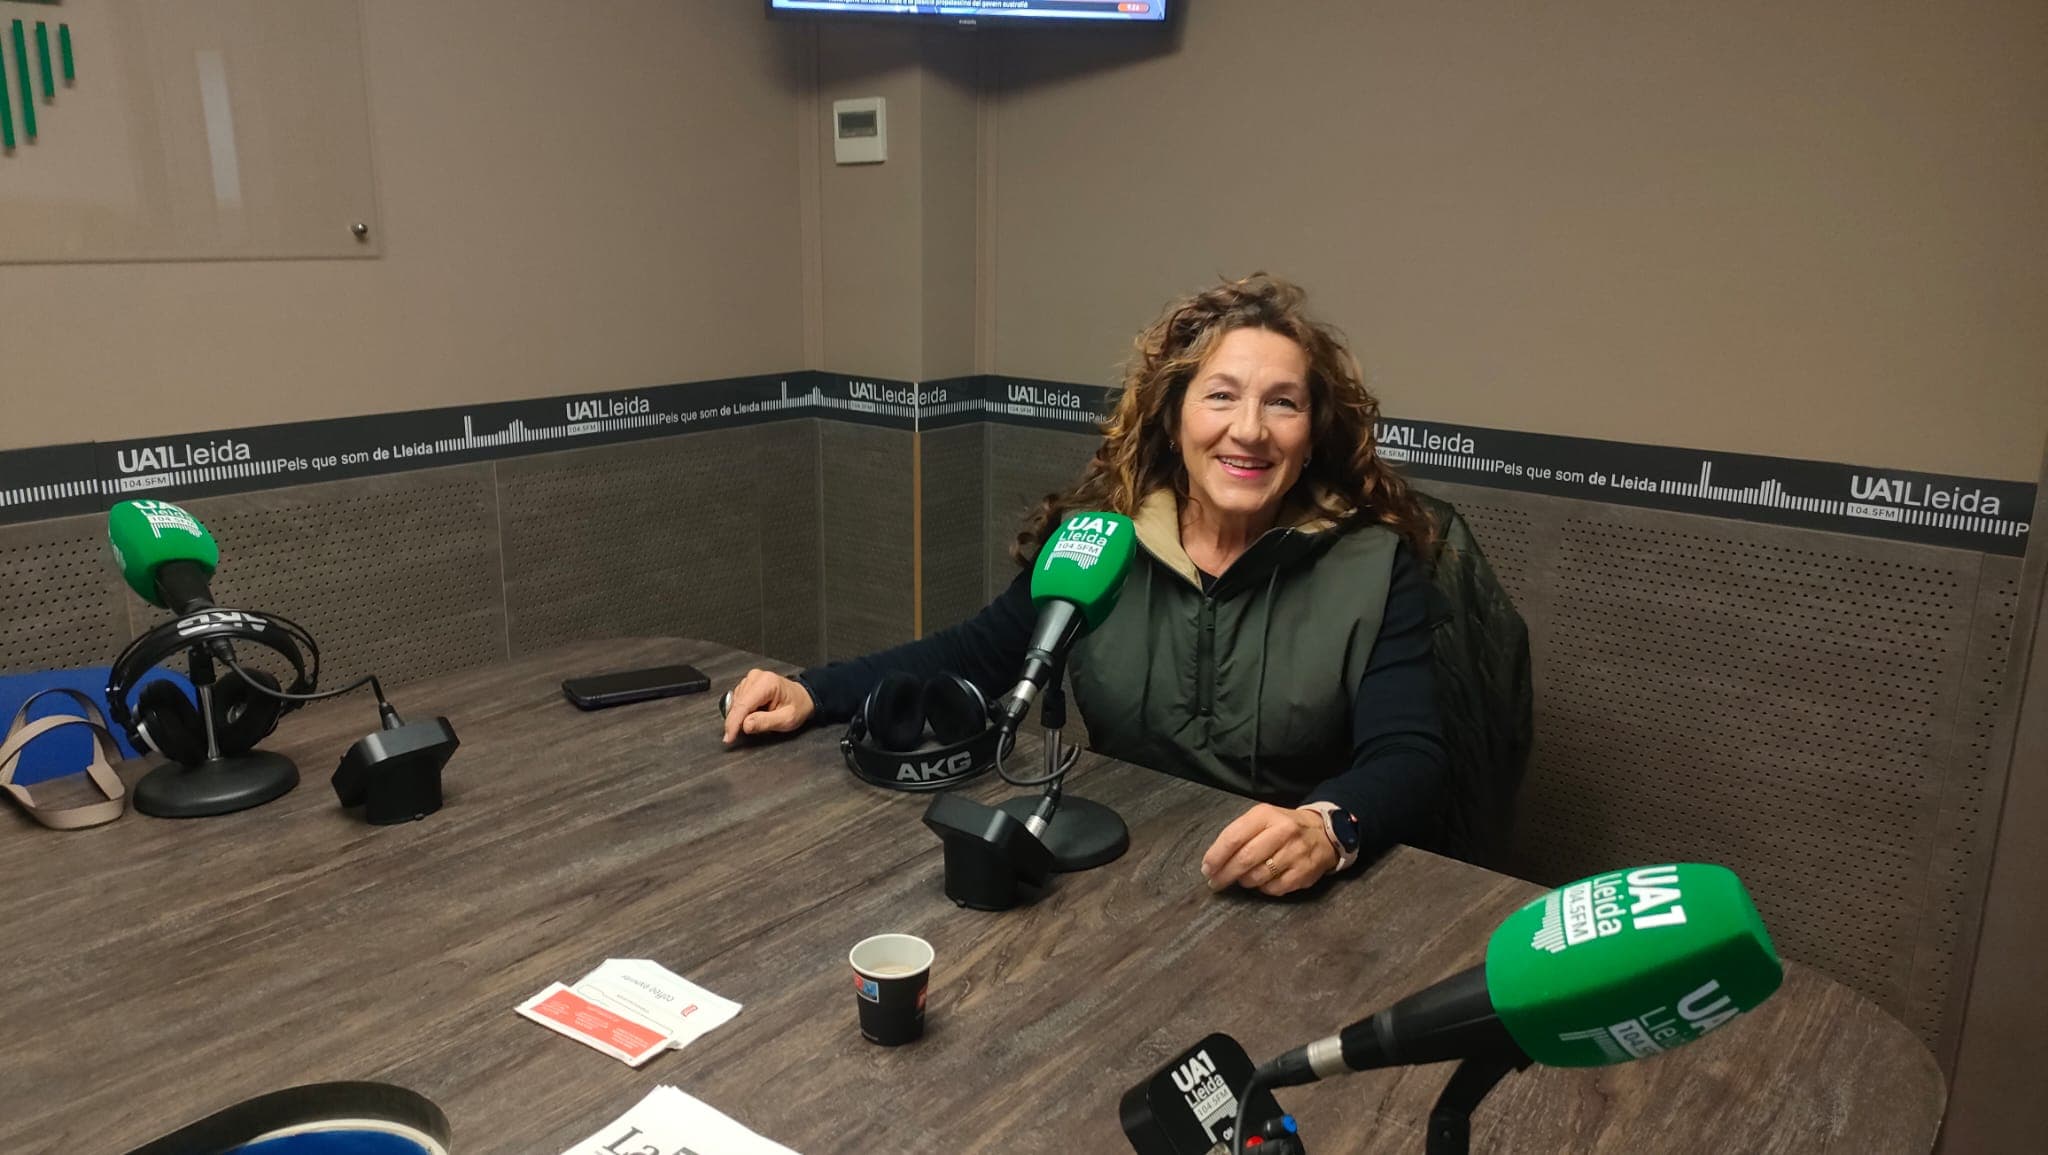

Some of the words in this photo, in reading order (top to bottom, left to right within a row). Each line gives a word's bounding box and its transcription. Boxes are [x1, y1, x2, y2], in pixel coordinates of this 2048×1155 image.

[566, 396, 650, 422] UA1Lleida
[1008, 384, 1080, 408] UA1Lleida
[659, 411, 679, 425] Pels
[680, 410, 698, 425] que
[700, 407, 718, 420] som
[720, 404, 732, 417] de
[733, 401, 760, 416] Lleida
[1374, 423, 1475, 455] UA1Lleida
[118, 440, 251, 473] UA1Lleida
[277, 457, 309, 474] Pels
[311, 455, 338, 472] que
[341, 450, 369, 465] som
[372, 447, 390, 462] de
[393, 443, 434, 460] Lleida
[1495, 460, 1523, 477] Pels
[1526, 465, 1552, 481] que
[1555, 470, 1585, 484] som
[1588, 471, 1607, 486] de
[1611, 473, 1657, 493] Lleida
[1850, 475, 2001, 516] UA1Lleida
[1067, 517, 1119, 537] UA1
[1849, 504, 1897, 520] 104.5FM
[1059, 530, 1108, 547] Lleida
[896, 750, 972, 782] AKG
[1593, 872, 1628, 937] Lleida
[1627, 865, 1688, 930] UA1
[1171, 1049, 1216, 1092] UA1
[1184, 1074, 1226, 1109] Lleida
